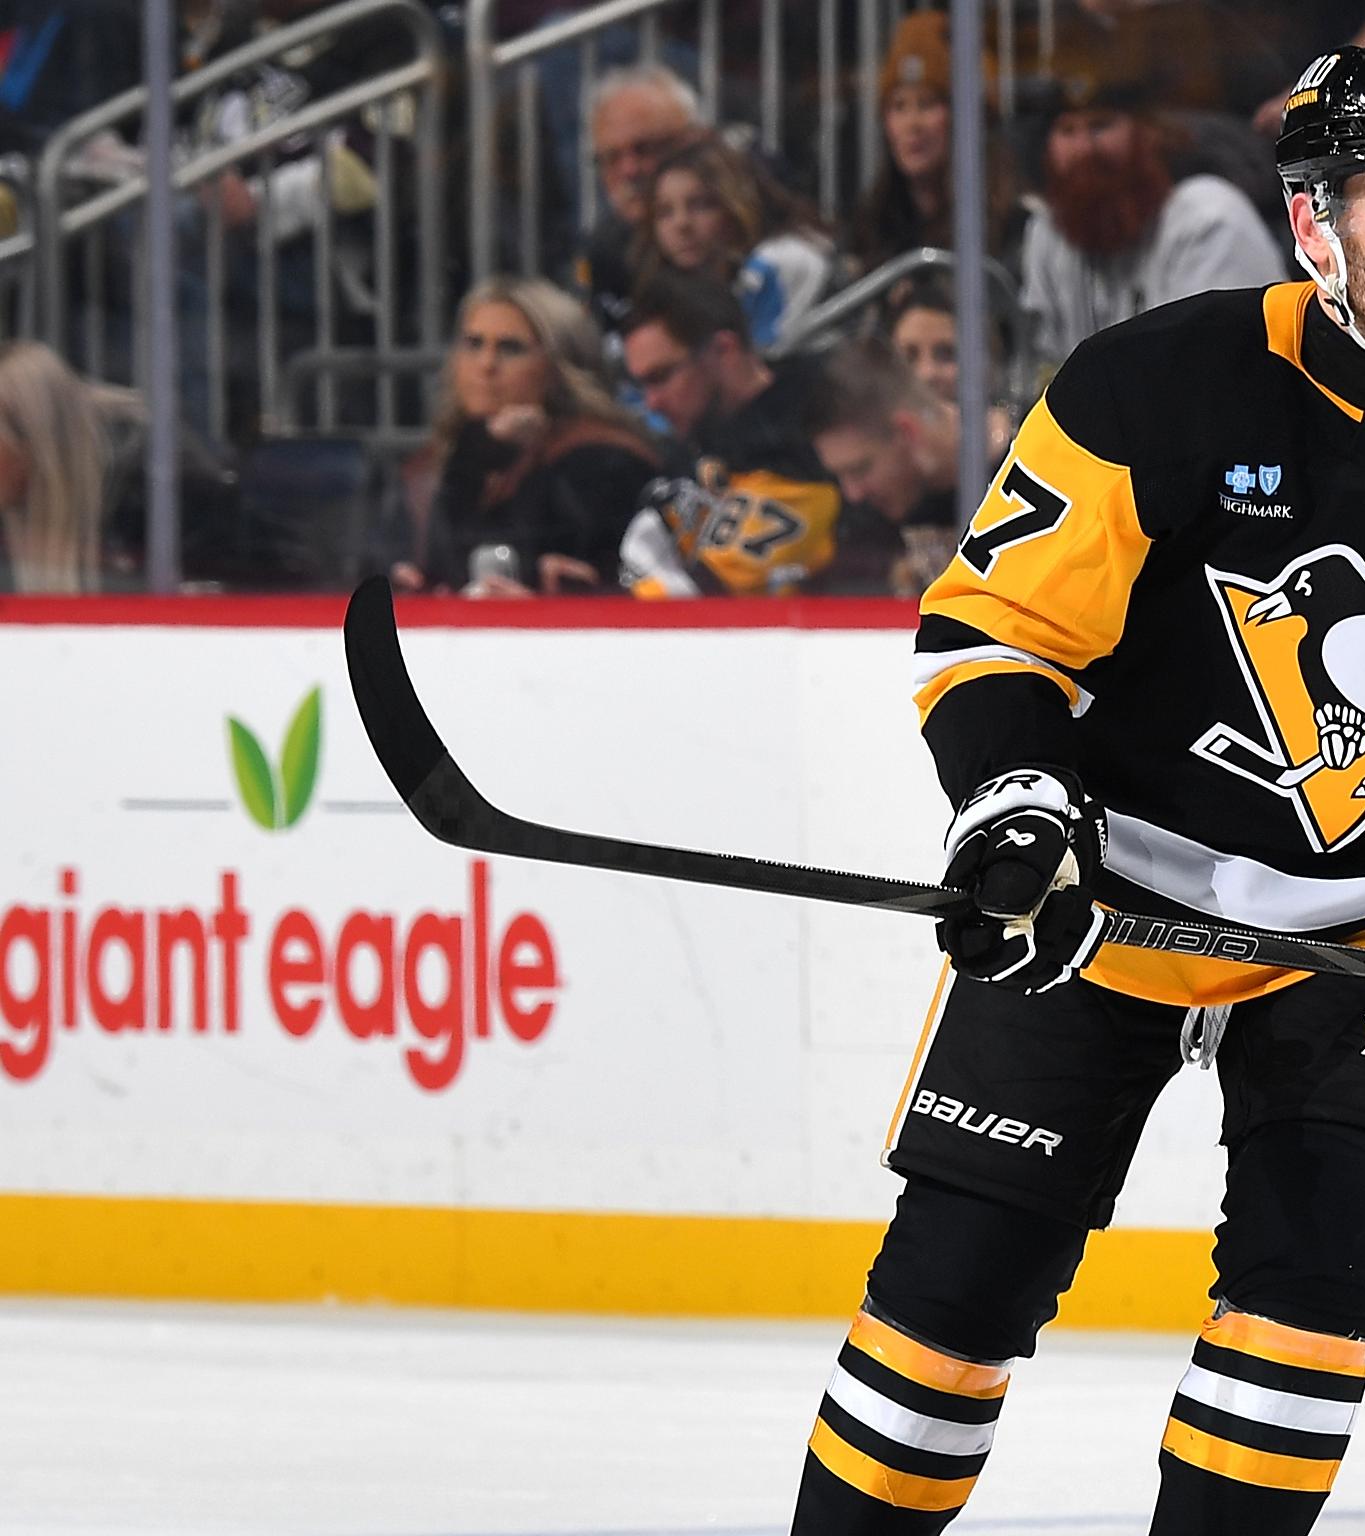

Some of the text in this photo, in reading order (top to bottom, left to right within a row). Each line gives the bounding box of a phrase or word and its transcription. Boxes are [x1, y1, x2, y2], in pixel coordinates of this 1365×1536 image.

[1291, 54, 1341, 96] OLD
[701, 493, 808, 560] 87
[0, 858, 560, 1092] giant eagle
